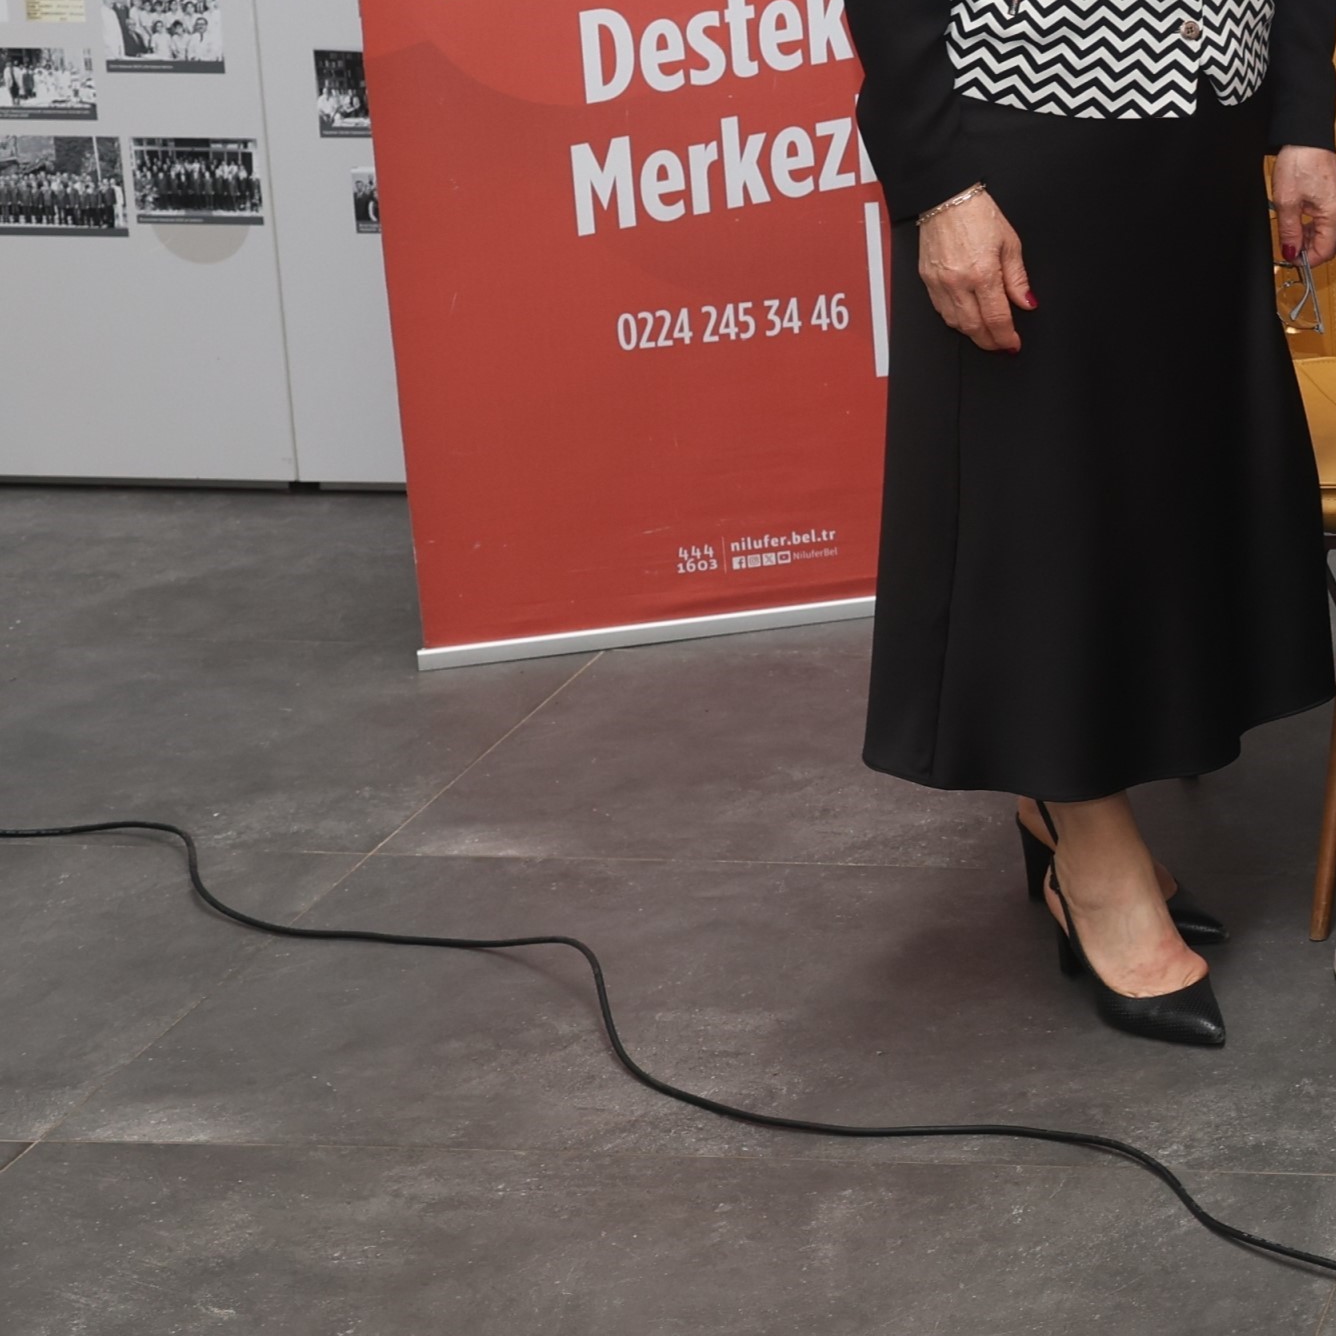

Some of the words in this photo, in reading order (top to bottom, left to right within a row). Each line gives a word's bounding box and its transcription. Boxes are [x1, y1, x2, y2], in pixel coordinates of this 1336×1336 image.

[617, 304, 694, 351] 0224
[702, 300, 757, 344] 245
[763, 296, 803, 337] 34
[810, 292, 850, 331] 46
[730, 529, 836, 552] nilufer.bel.tr
[678, 543, 714, 561] 444
[793, 547, 838, 560] NiluferBel
[677, 558, 719, 574] 1603
